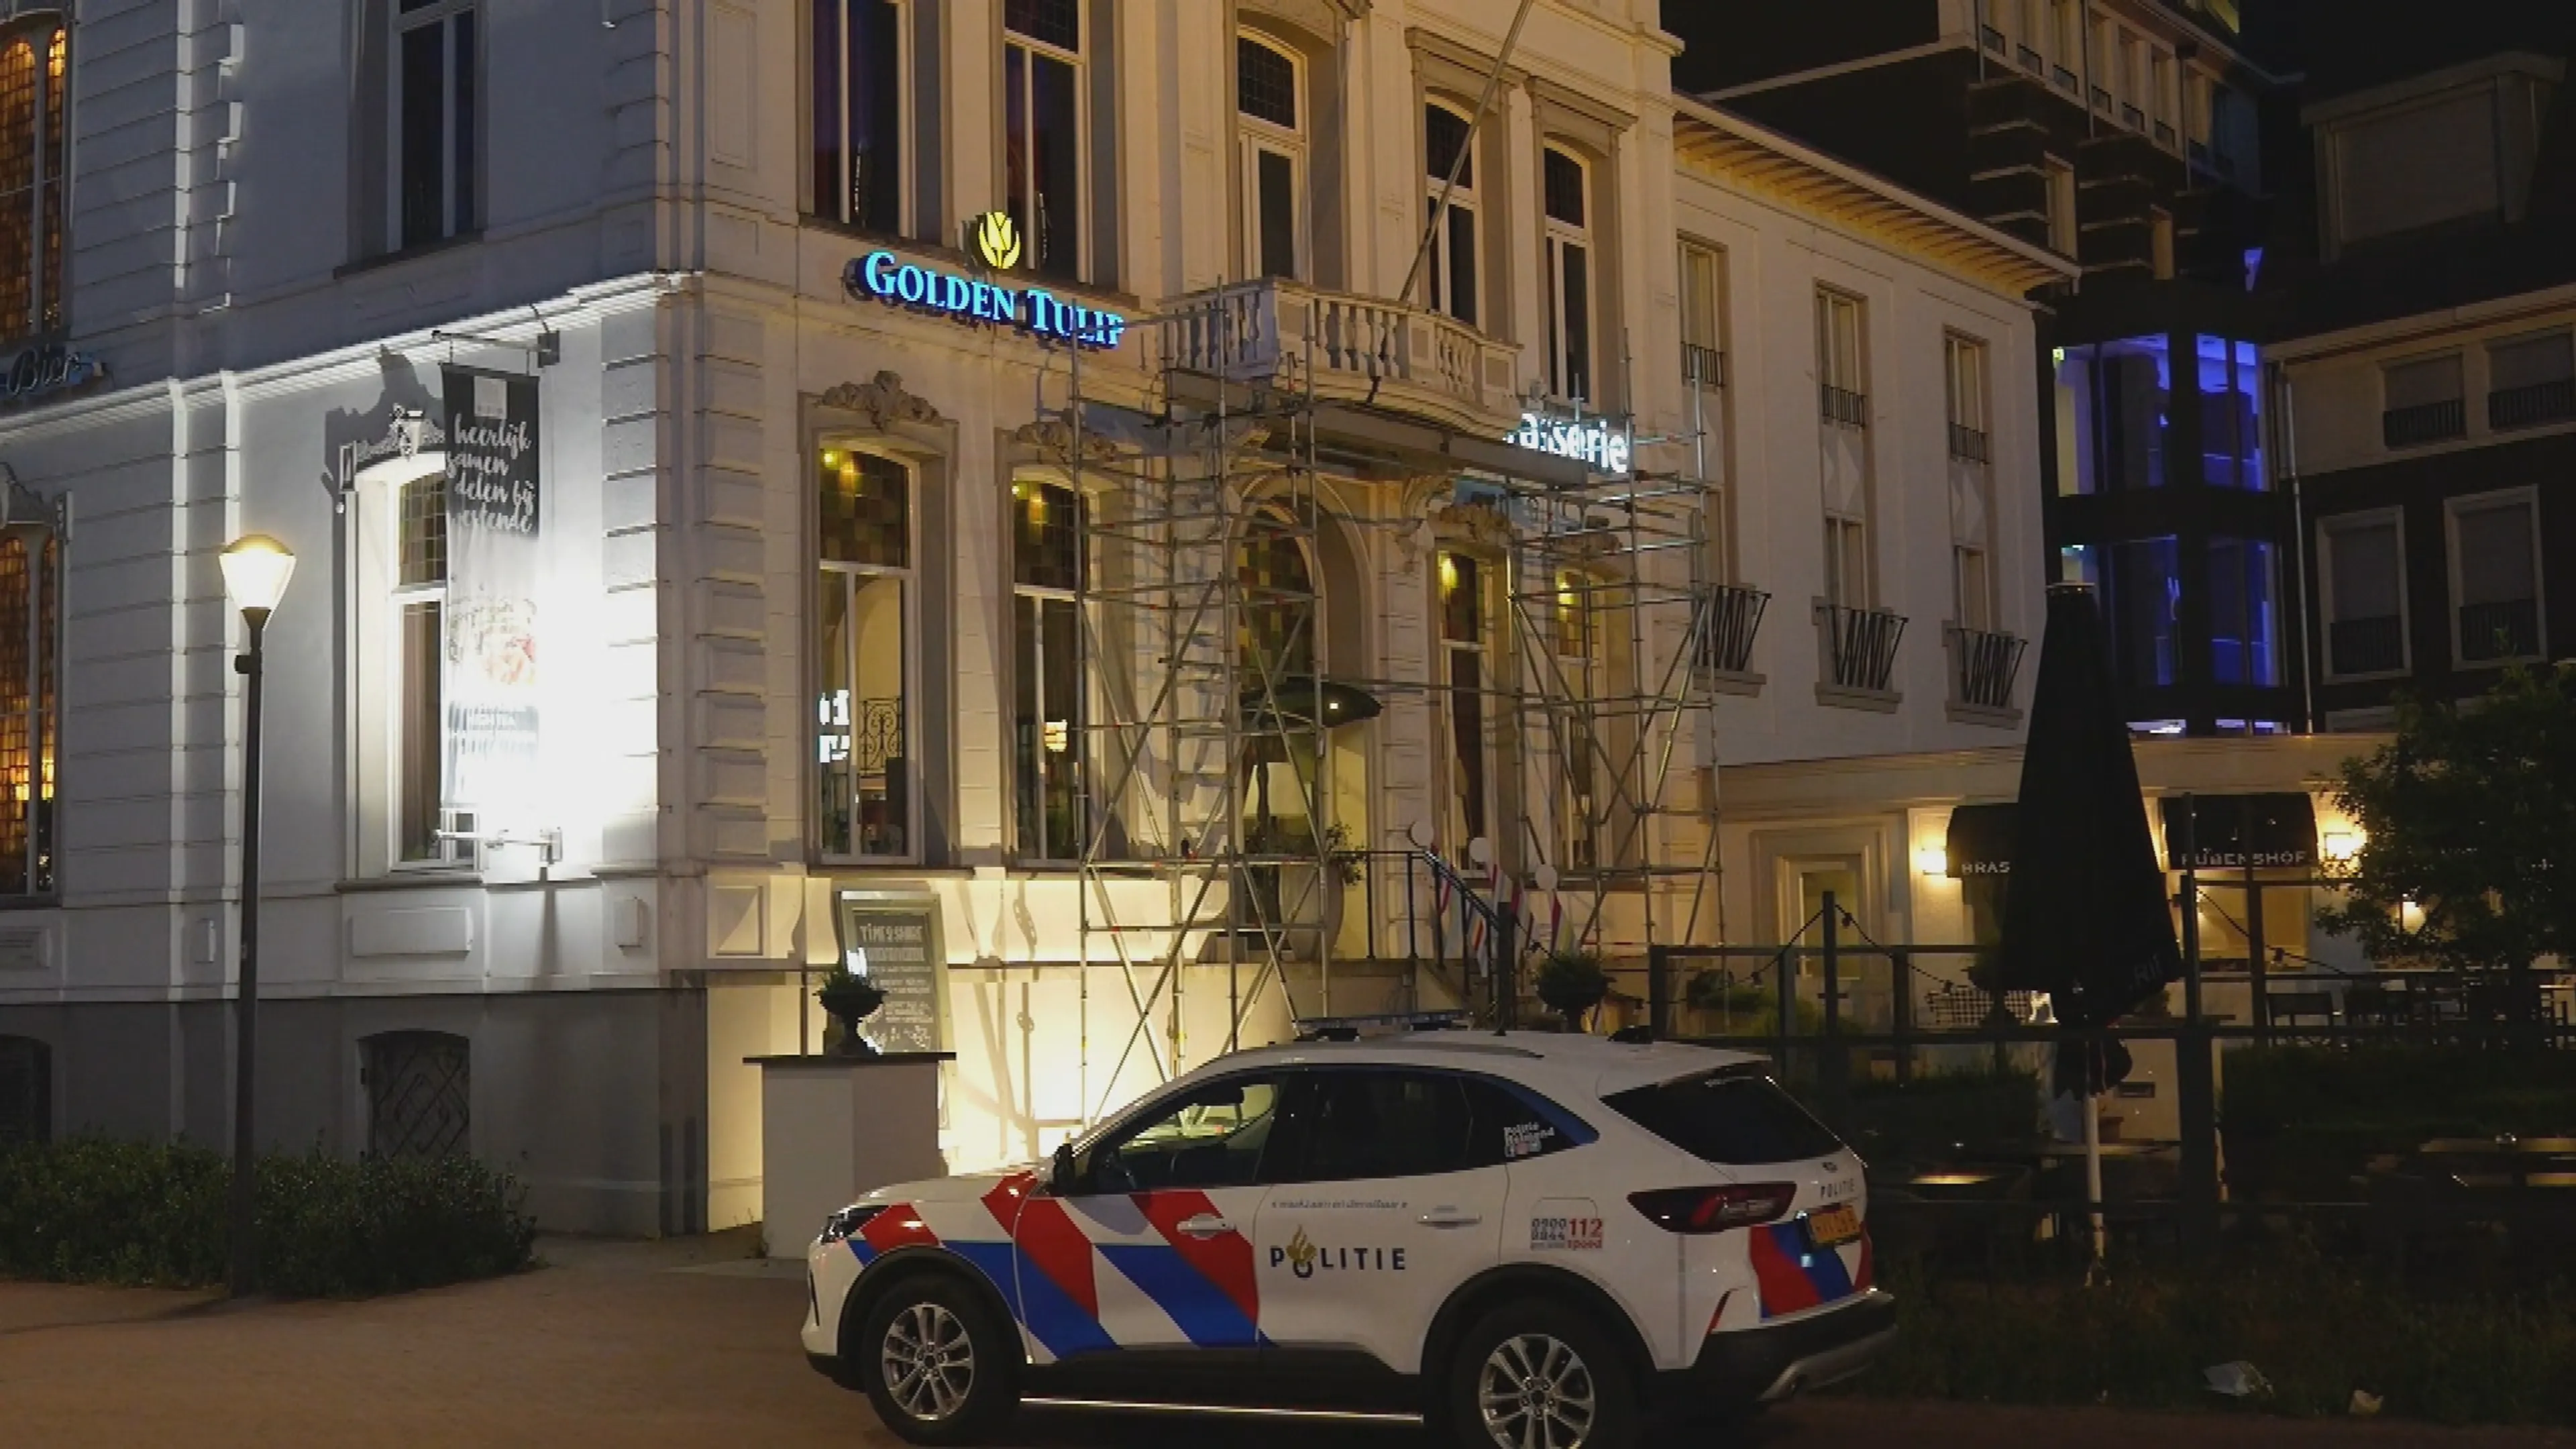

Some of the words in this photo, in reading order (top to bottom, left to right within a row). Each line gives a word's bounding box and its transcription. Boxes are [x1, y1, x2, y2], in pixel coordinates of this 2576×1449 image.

[865, 251, 1016, 321] GOLDEN
[1026, 288, 1125, 347] TULIP
[454, 413, 531, 459] heerlijk
[1503, 413, 1628, 473] asserie
[1568, 1218, 1603, 1237] 112
[1270, 1247, 1406, 1279] POLITIE
